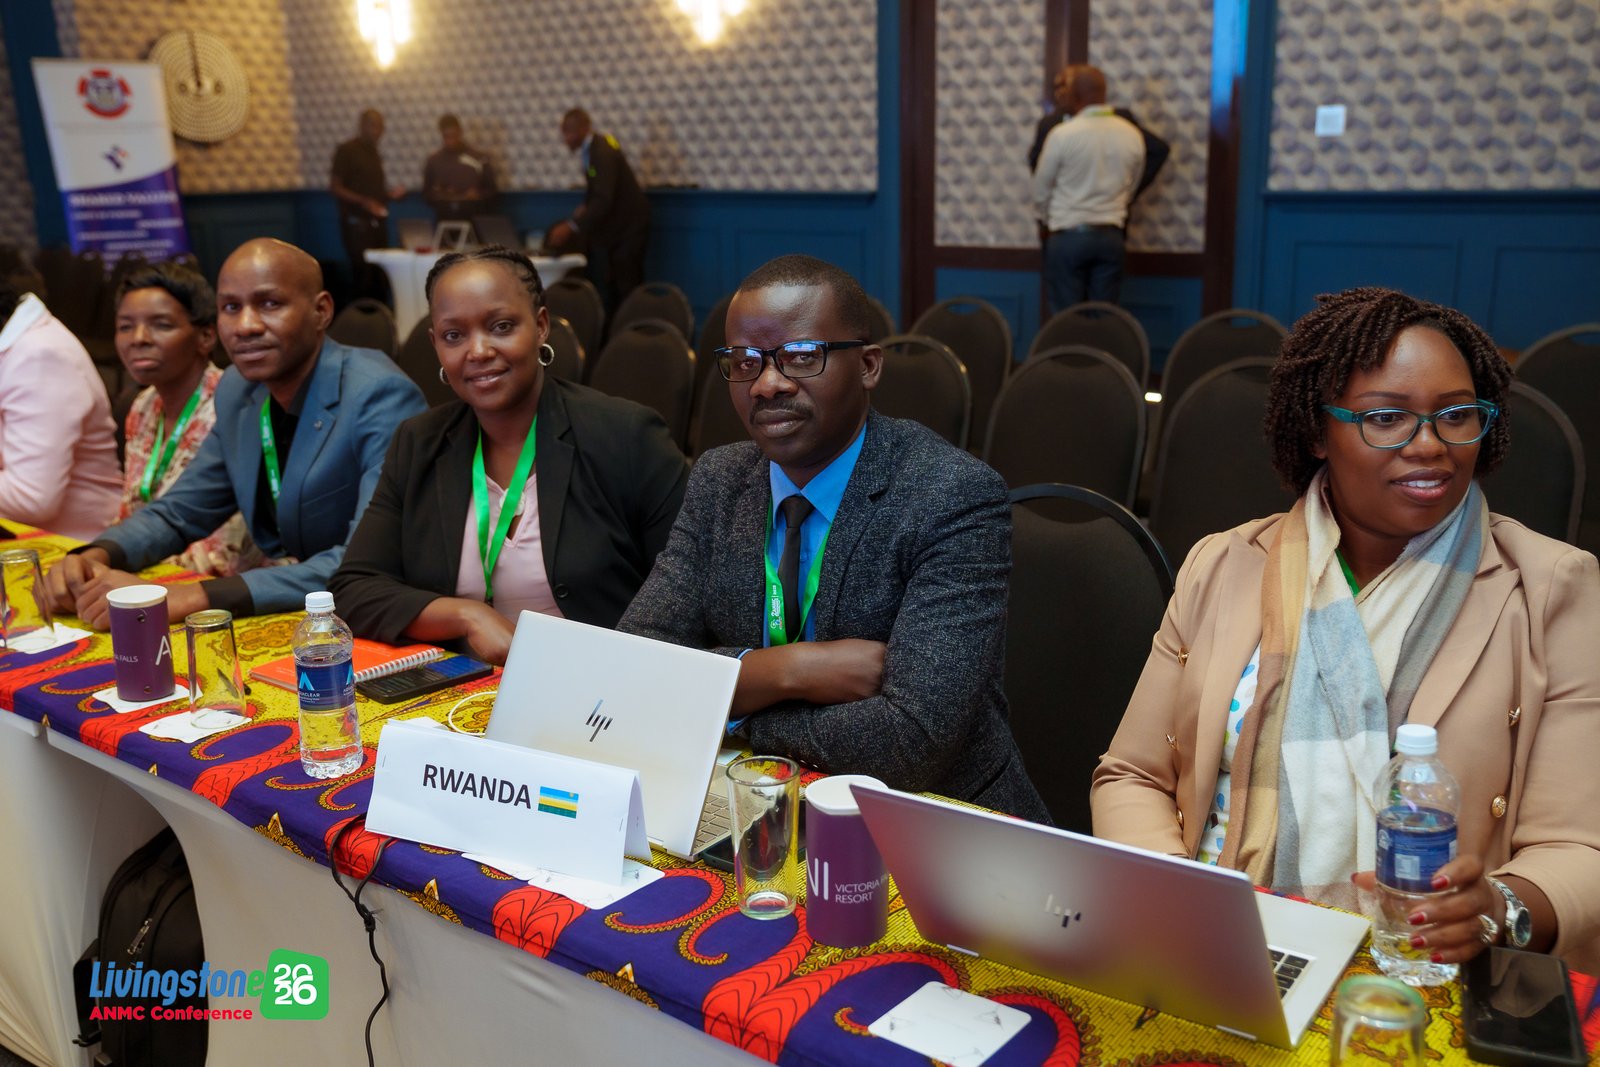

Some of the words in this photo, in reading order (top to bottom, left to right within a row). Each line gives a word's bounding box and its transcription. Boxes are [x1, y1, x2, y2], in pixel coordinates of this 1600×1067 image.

[155, 635, 172, 665] A
[585, 699, 613, 742] hp
[422, 764, 531, 809] RWANDA
[834, 879, 880, 894] VICTORIA
[835, 891, 874, 904] RESORT
